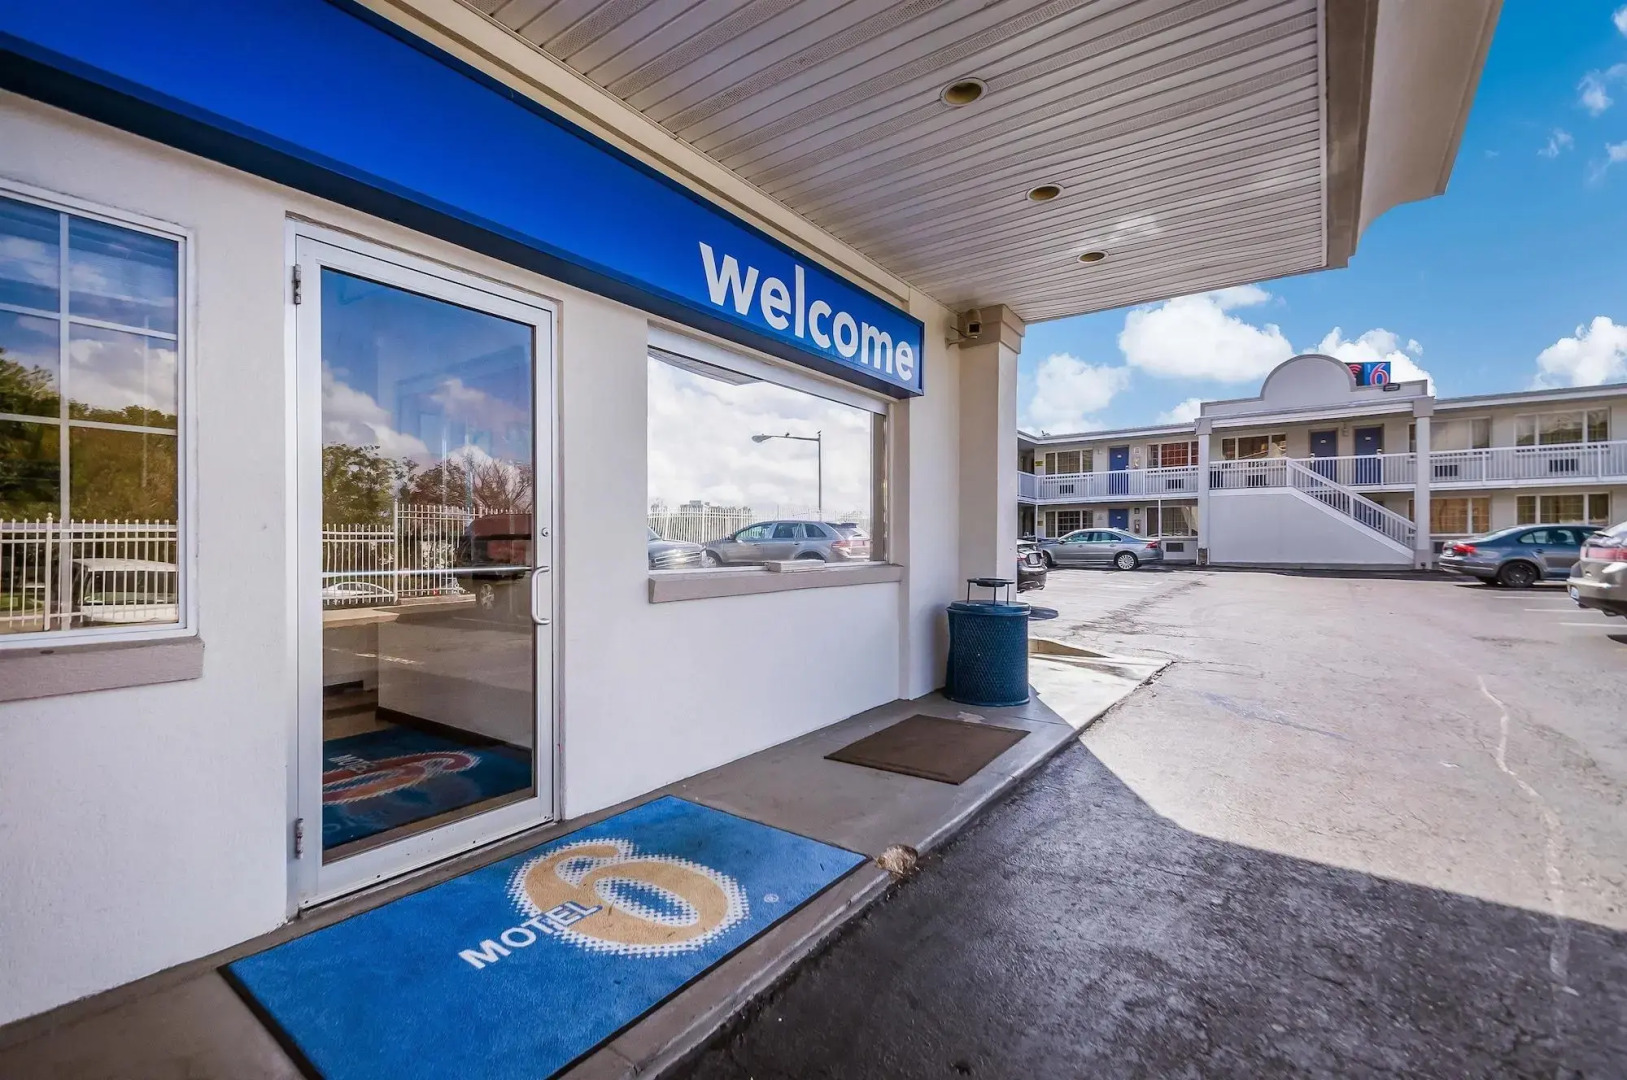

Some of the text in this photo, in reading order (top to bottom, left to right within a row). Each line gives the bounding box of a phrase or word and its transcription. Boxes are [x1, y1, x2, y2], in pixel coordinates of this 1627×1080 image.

[699, 241, 914, 381] welcome
[1370, 363, 1390, 388] 6
[459, 841, 740, 969] MOTEL 6
